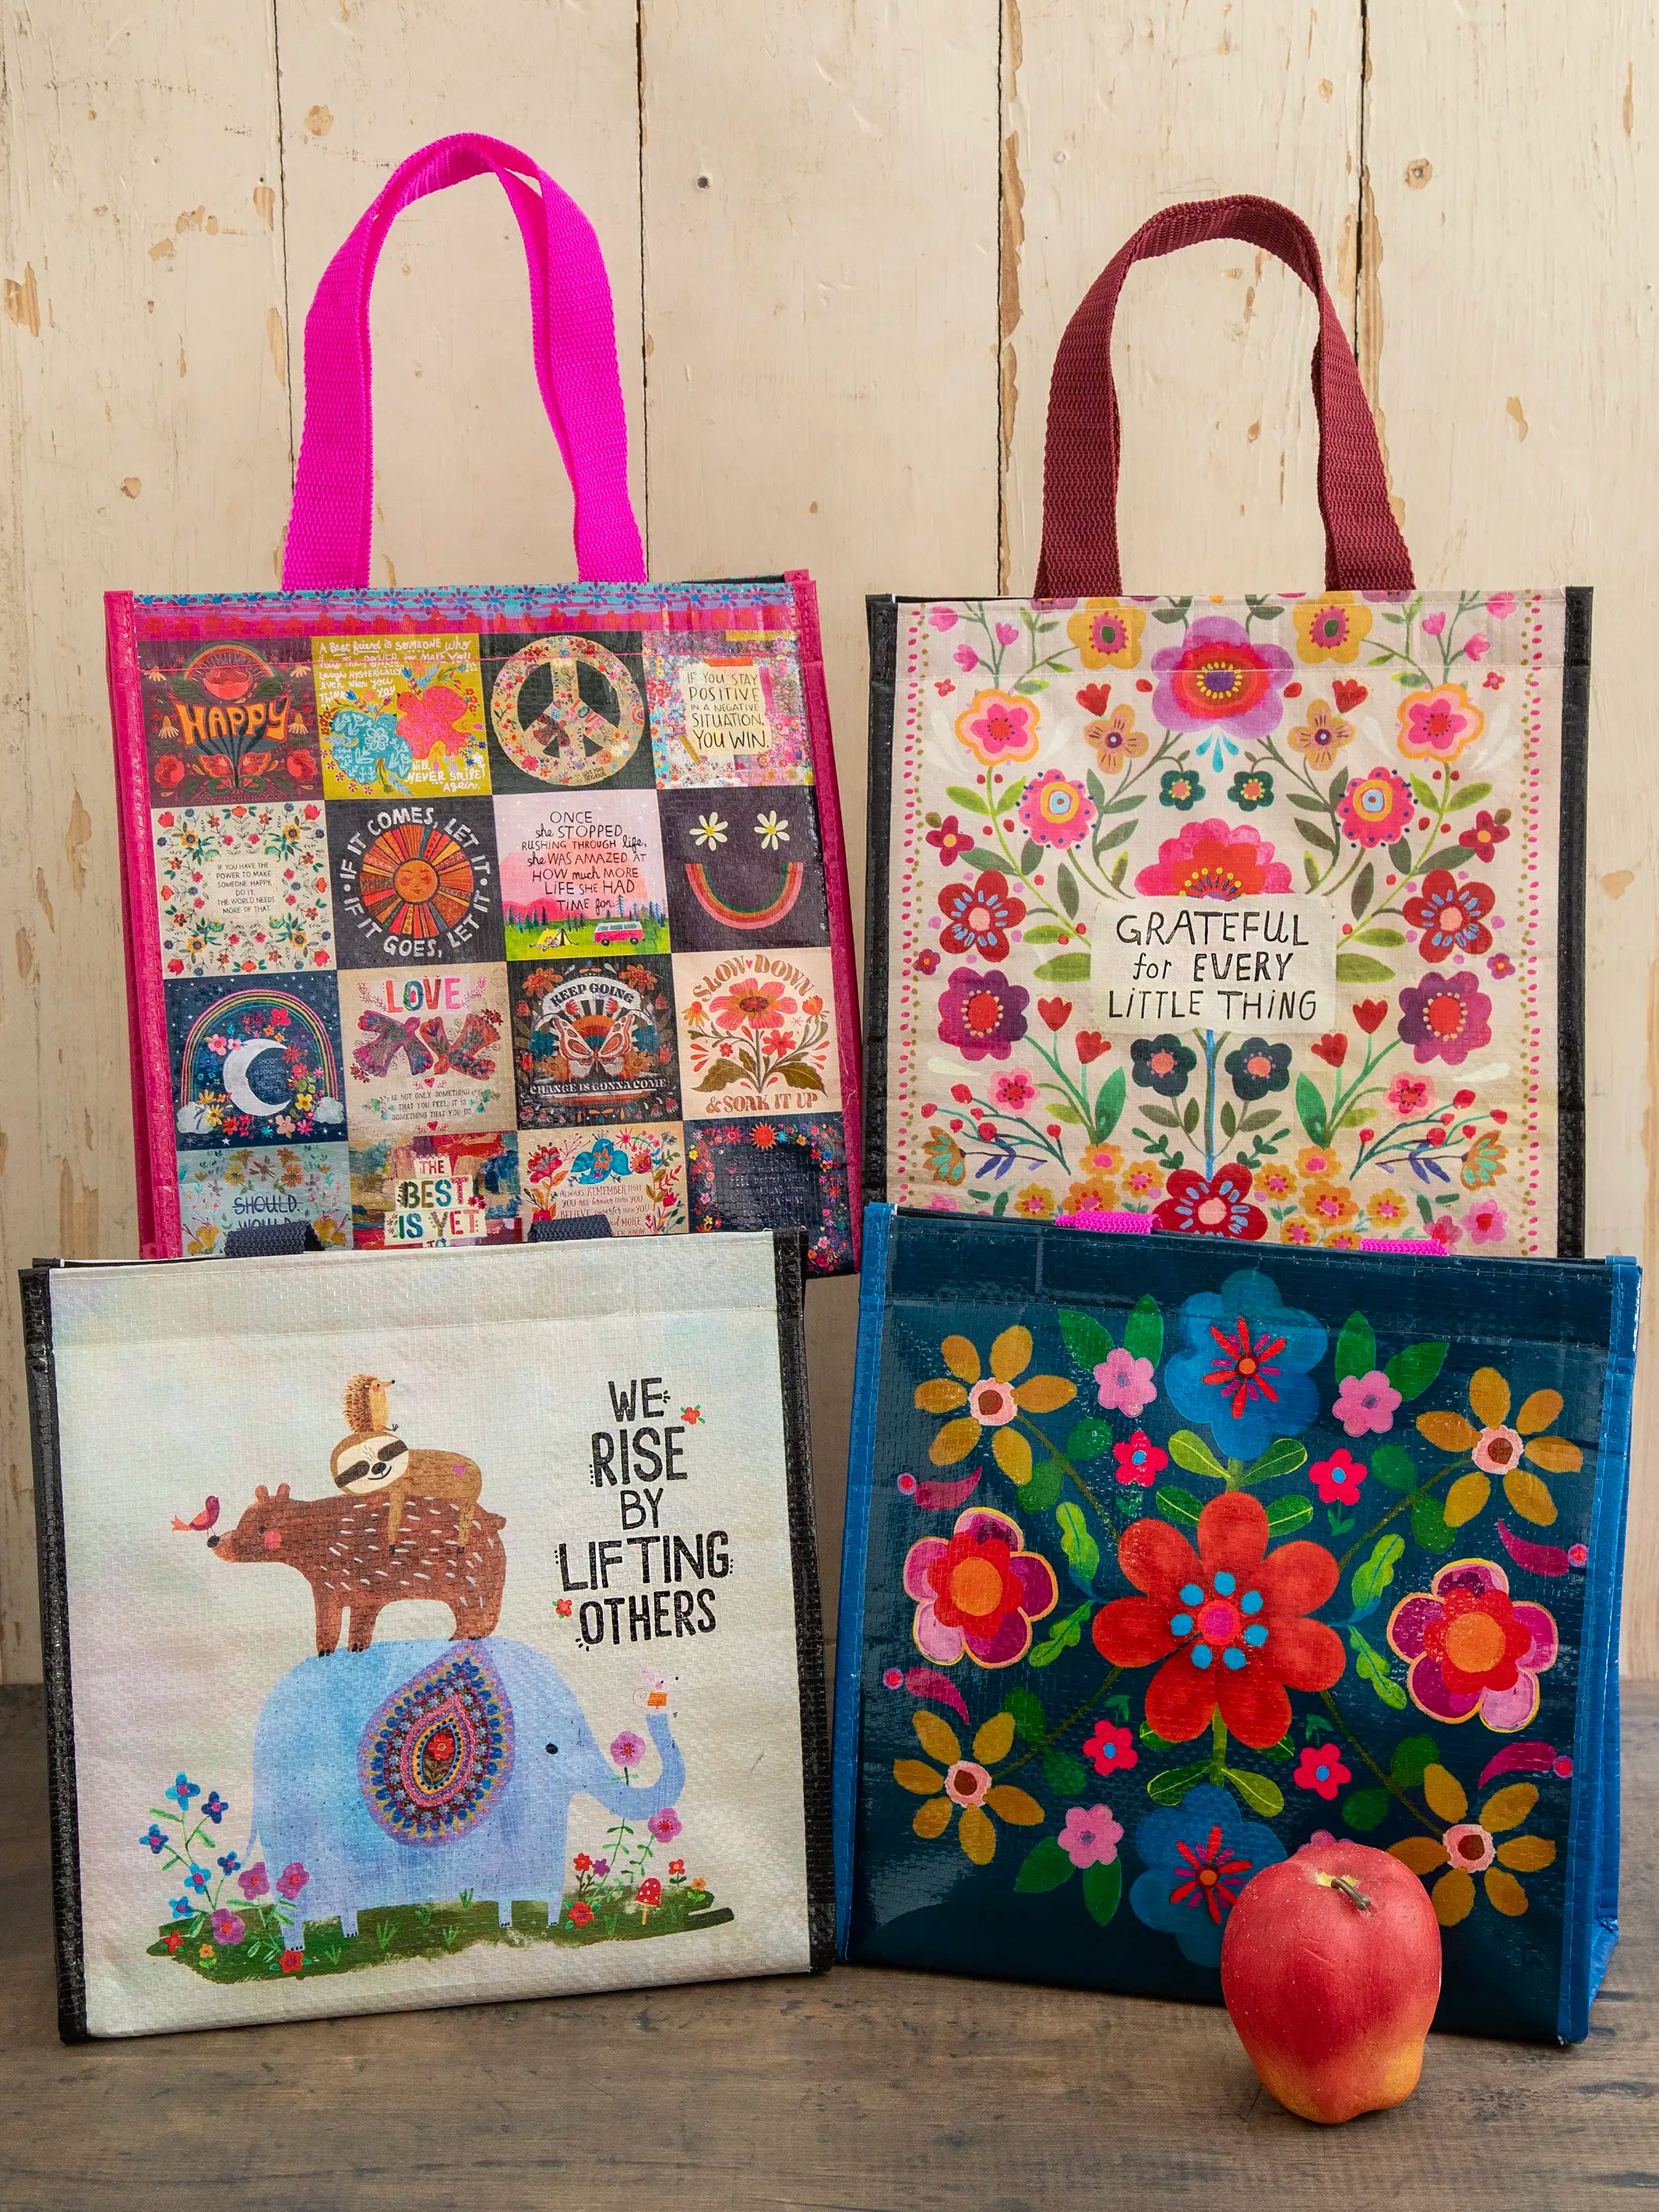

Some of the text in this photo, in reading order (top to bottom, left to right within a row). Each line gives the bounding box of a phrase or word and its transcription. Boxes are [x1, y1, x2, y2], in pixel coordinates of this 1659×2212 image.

[319, 642, 327, 654] A
[395, 638, 441, 650] SOMEONE
[687, 671, 758, 685] IF YOU STAY
[689, 687, 759, 702] POSITIVE
[174, 697, 291, 747] HAPPY
[569, 698, 604, 735] LOVE
[692, 730, 769, 749] YOU WIN.
[407, 770, 446, 783] NEVER
[550, 812, 592, 823] ONCE
[536, 823, 623, 839] she STOPPED
[340, 807, 490, 879] IF IT COMES, LET IT
[572, 840, 616, 850] THROUGH
[528, 852, 646, 867] she WAS AMAZED AT
[532, 866, 639, 882] HOW much MORE
[579, 883, 597, 895] SHE
[603, 879, 635, 894] HAD
[344, 889, 490, 958] IF IT GOES, LET IT
[1116, 910, 1309, 946] GRATEFUL
[1133, 952, 1293, 981] for EVERY
[692, 954, 815, 1002] SLOW DOWN
[386, 977, 462, 1013] LOVE
[550, 983, 635, 1007] KEEP GOING
[530, 1083, 576, 1095] CHANGE
[592, 1080, 631, 1091] GONNA
[633, 1079, 667, 1089] COME
[724, 1094, 770, 1113] SOAK
[774, 1093, 791, 1109] IT
[797, 1092, 818, 1108] UP
[392, 1111, 427, 1121] SOMETHING
[430, 1110, 445, 1118] THAT
[419, 1160, 445, 1174] THE
[400, 1177, 468, 1208] BEST
[560, 1189, 584, 1198] ALWAYS
[587, 1185, 626, 1196] REMEMBER
[562, 1199, 576, 1208] YOU
[636, 1204, 650, 1213] YOU
[397, 1210, 480, 1239] IS YET
[622, 1217, 641, 1227] MORE
[608, 1377, 664, 1422] WE
[592, 1426, 688, 1488] RISE
[620, 1488, 664, 1530] BY
[558, 1530, 729, 1591] LIFTING
[579, 1588, 716, 1645] OTHERS
